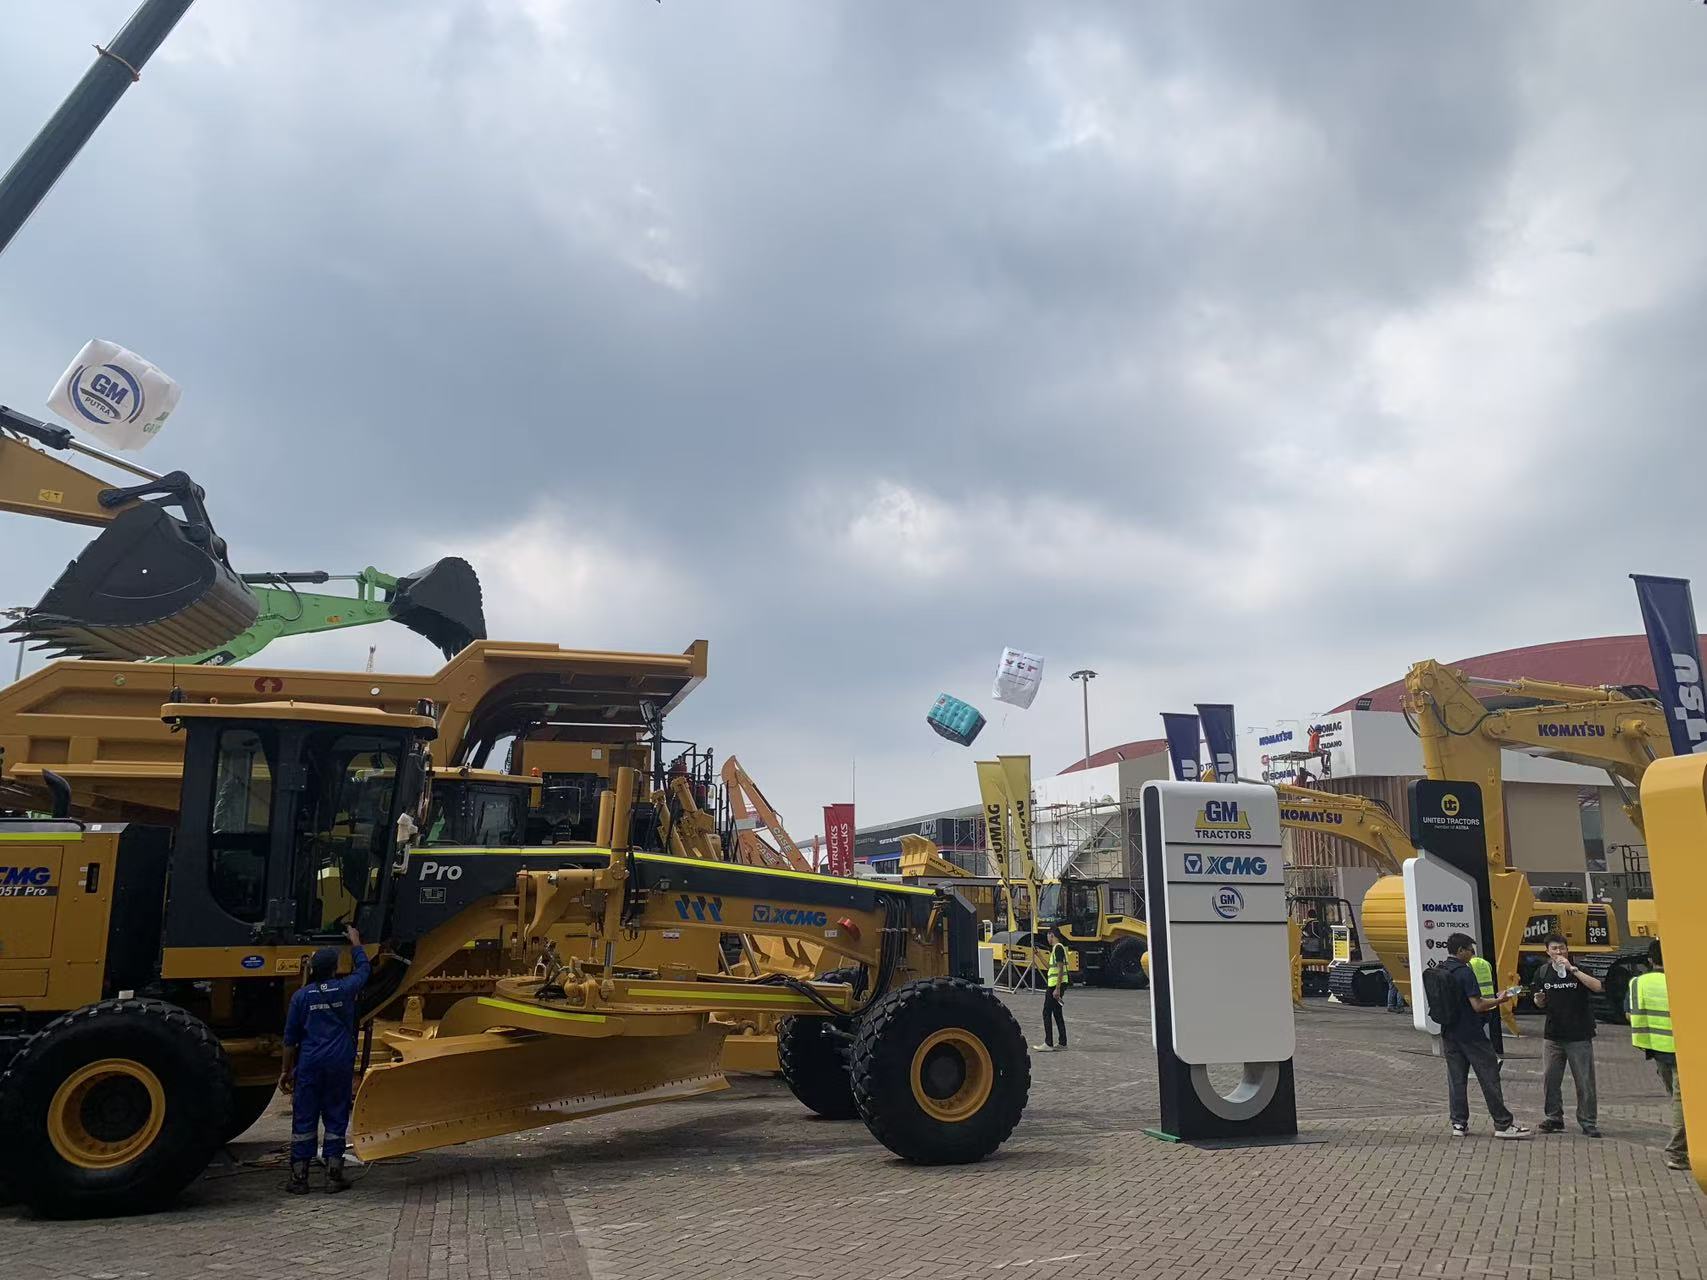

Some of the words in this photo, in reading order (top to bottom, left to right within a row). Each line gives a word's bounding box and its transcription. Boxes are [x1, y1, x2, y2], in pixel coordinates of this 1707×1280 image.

[91, 374, 128, 404] GM
[85, 396, 112, 416] PUTRA
[1538, 721, 1605, 737] KOMATSU
[1259, 731, 1293, 746] KOMATSU
[1321, 740, 1342, 749] TADANO
[1206, 800, 1238, 822] GM
[1281, 809, 1342, 824] KOMATSU
[1447, 818, 1480, 826] TRACTORS
[772, 827, 793, 853] CASE
[1195, 830, 1252, 839] TRACTORS
[419, 861, 463, 880] Pro
[1205, 856, 1267, 875] XCMG
[25, 886, 48, 896] Pro
[1220, 894, 1235, 905] GM
[1422, 903, 1464, 913] KOMATSU
[772, 908, 828, 928] XCMG
[1589, 927, 1607, 937] 365
